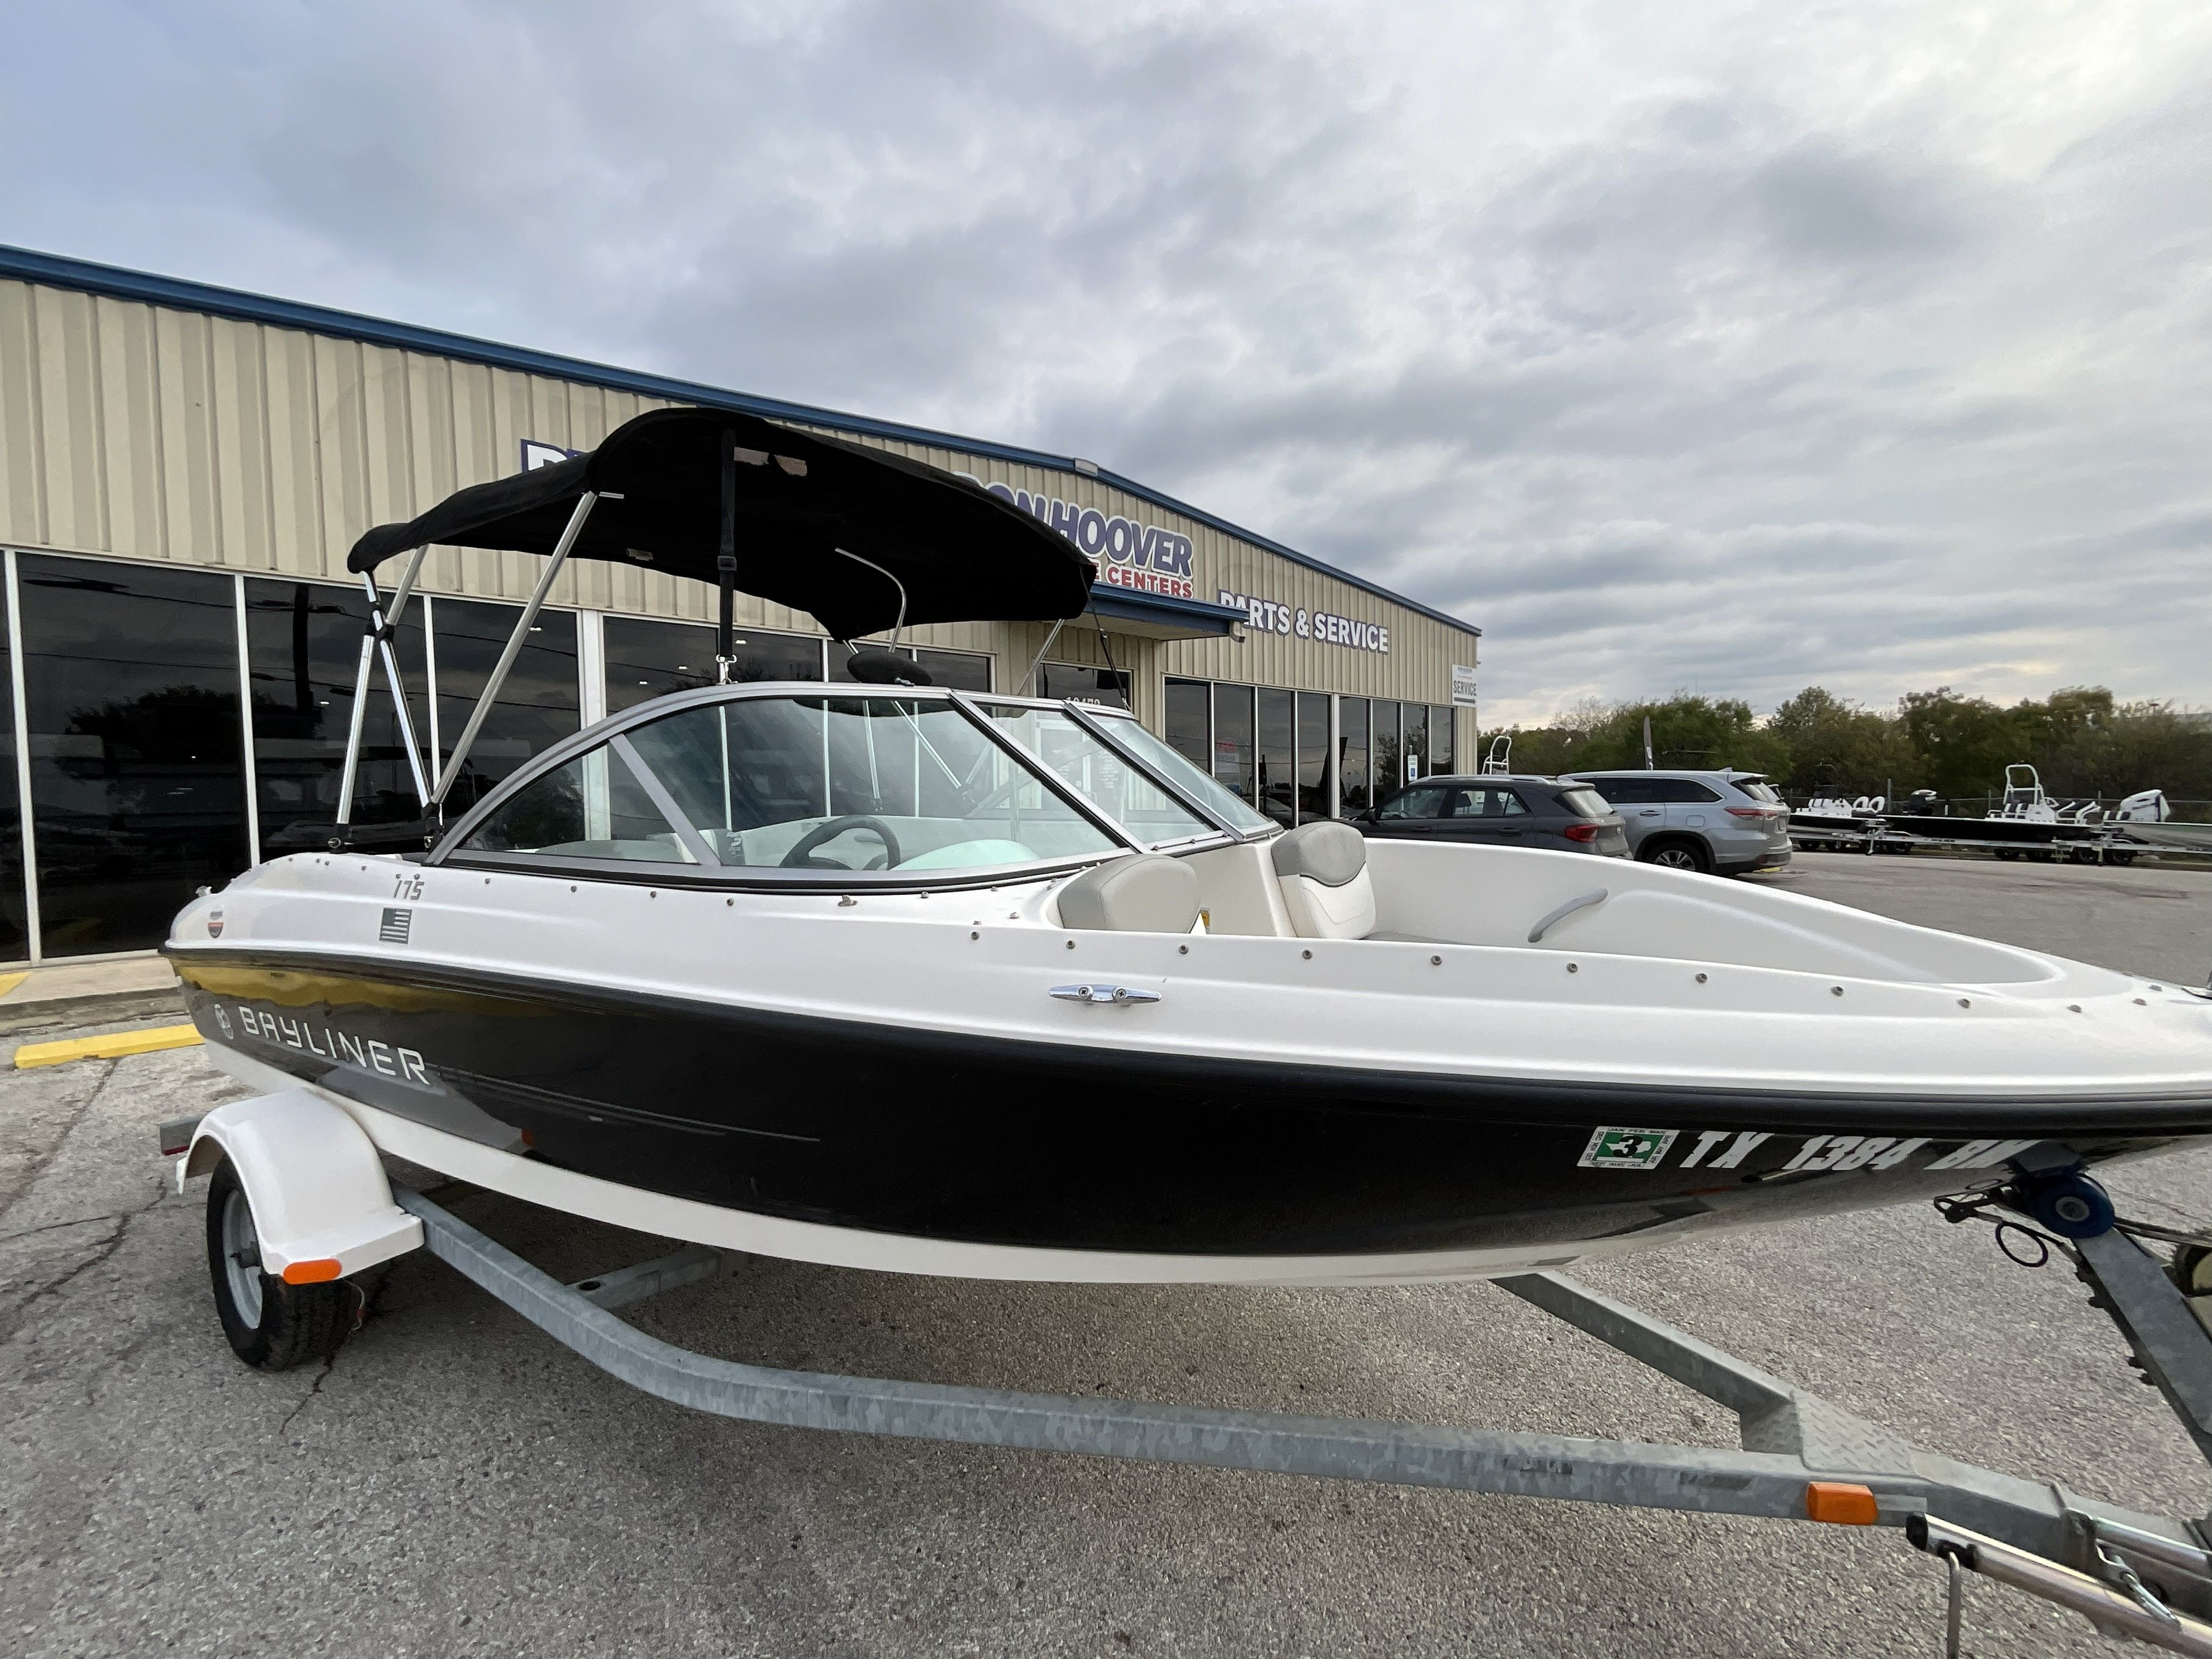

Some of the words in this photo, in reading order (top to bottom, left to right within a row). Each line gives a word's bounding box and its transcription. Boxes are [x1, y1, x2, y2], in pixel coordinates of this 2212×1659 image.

[1050, 499, 1193, 579] HOOVER
[1106, 566, 1193, 599] CENTERS
[1295, 608, 1309, 638] &
[1313, 611, 1389, 653] SERVICE
[1453, 680, 1477, 696] SERVICE
[393, 880, 425, 900] 175
[238, 1006, 430, 1085] BAYLINER
[1613, 1135, 1643, 1157] 3
[1679, 1130, 1775, 1169] TX
[1781, 1135, 1933, 1171] 1384
